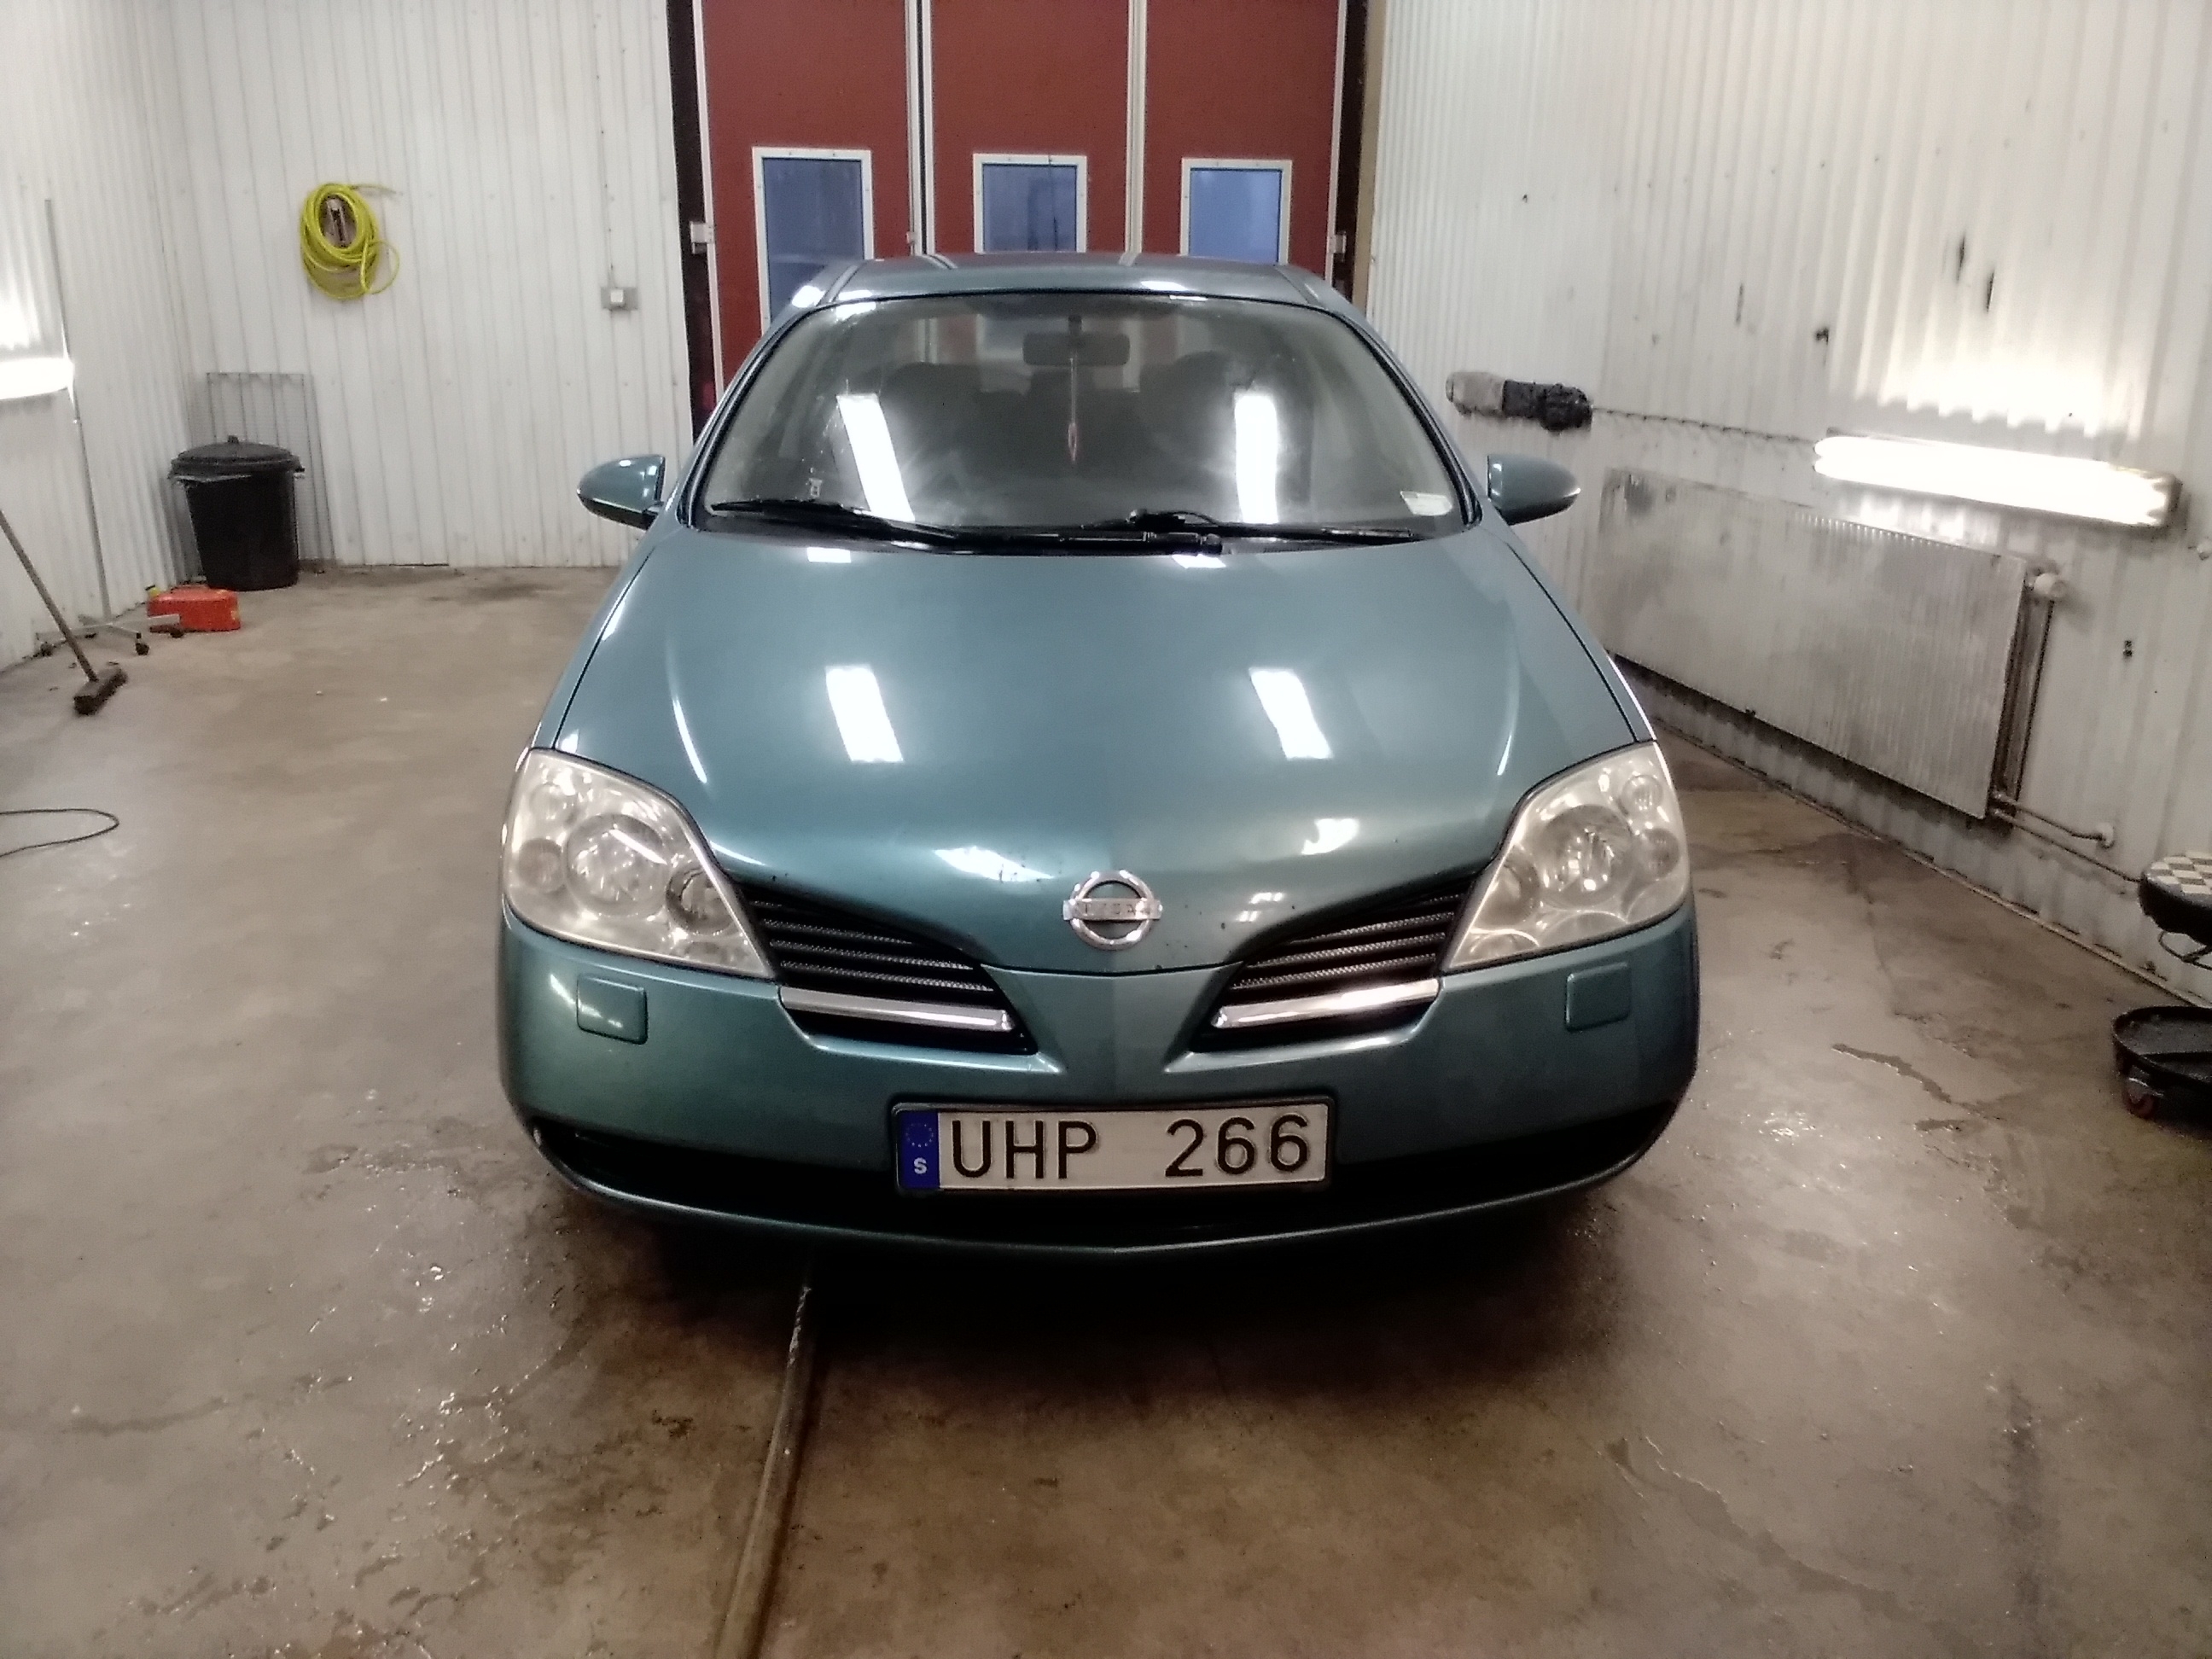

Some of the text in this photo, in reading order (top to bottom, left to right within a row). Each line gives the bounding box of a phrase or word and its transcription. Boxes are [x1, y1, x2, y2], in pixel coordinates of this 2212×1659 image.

[913, 1157, 928, 1174] S
[952, 1114, 1308, 1179] UHP 266
